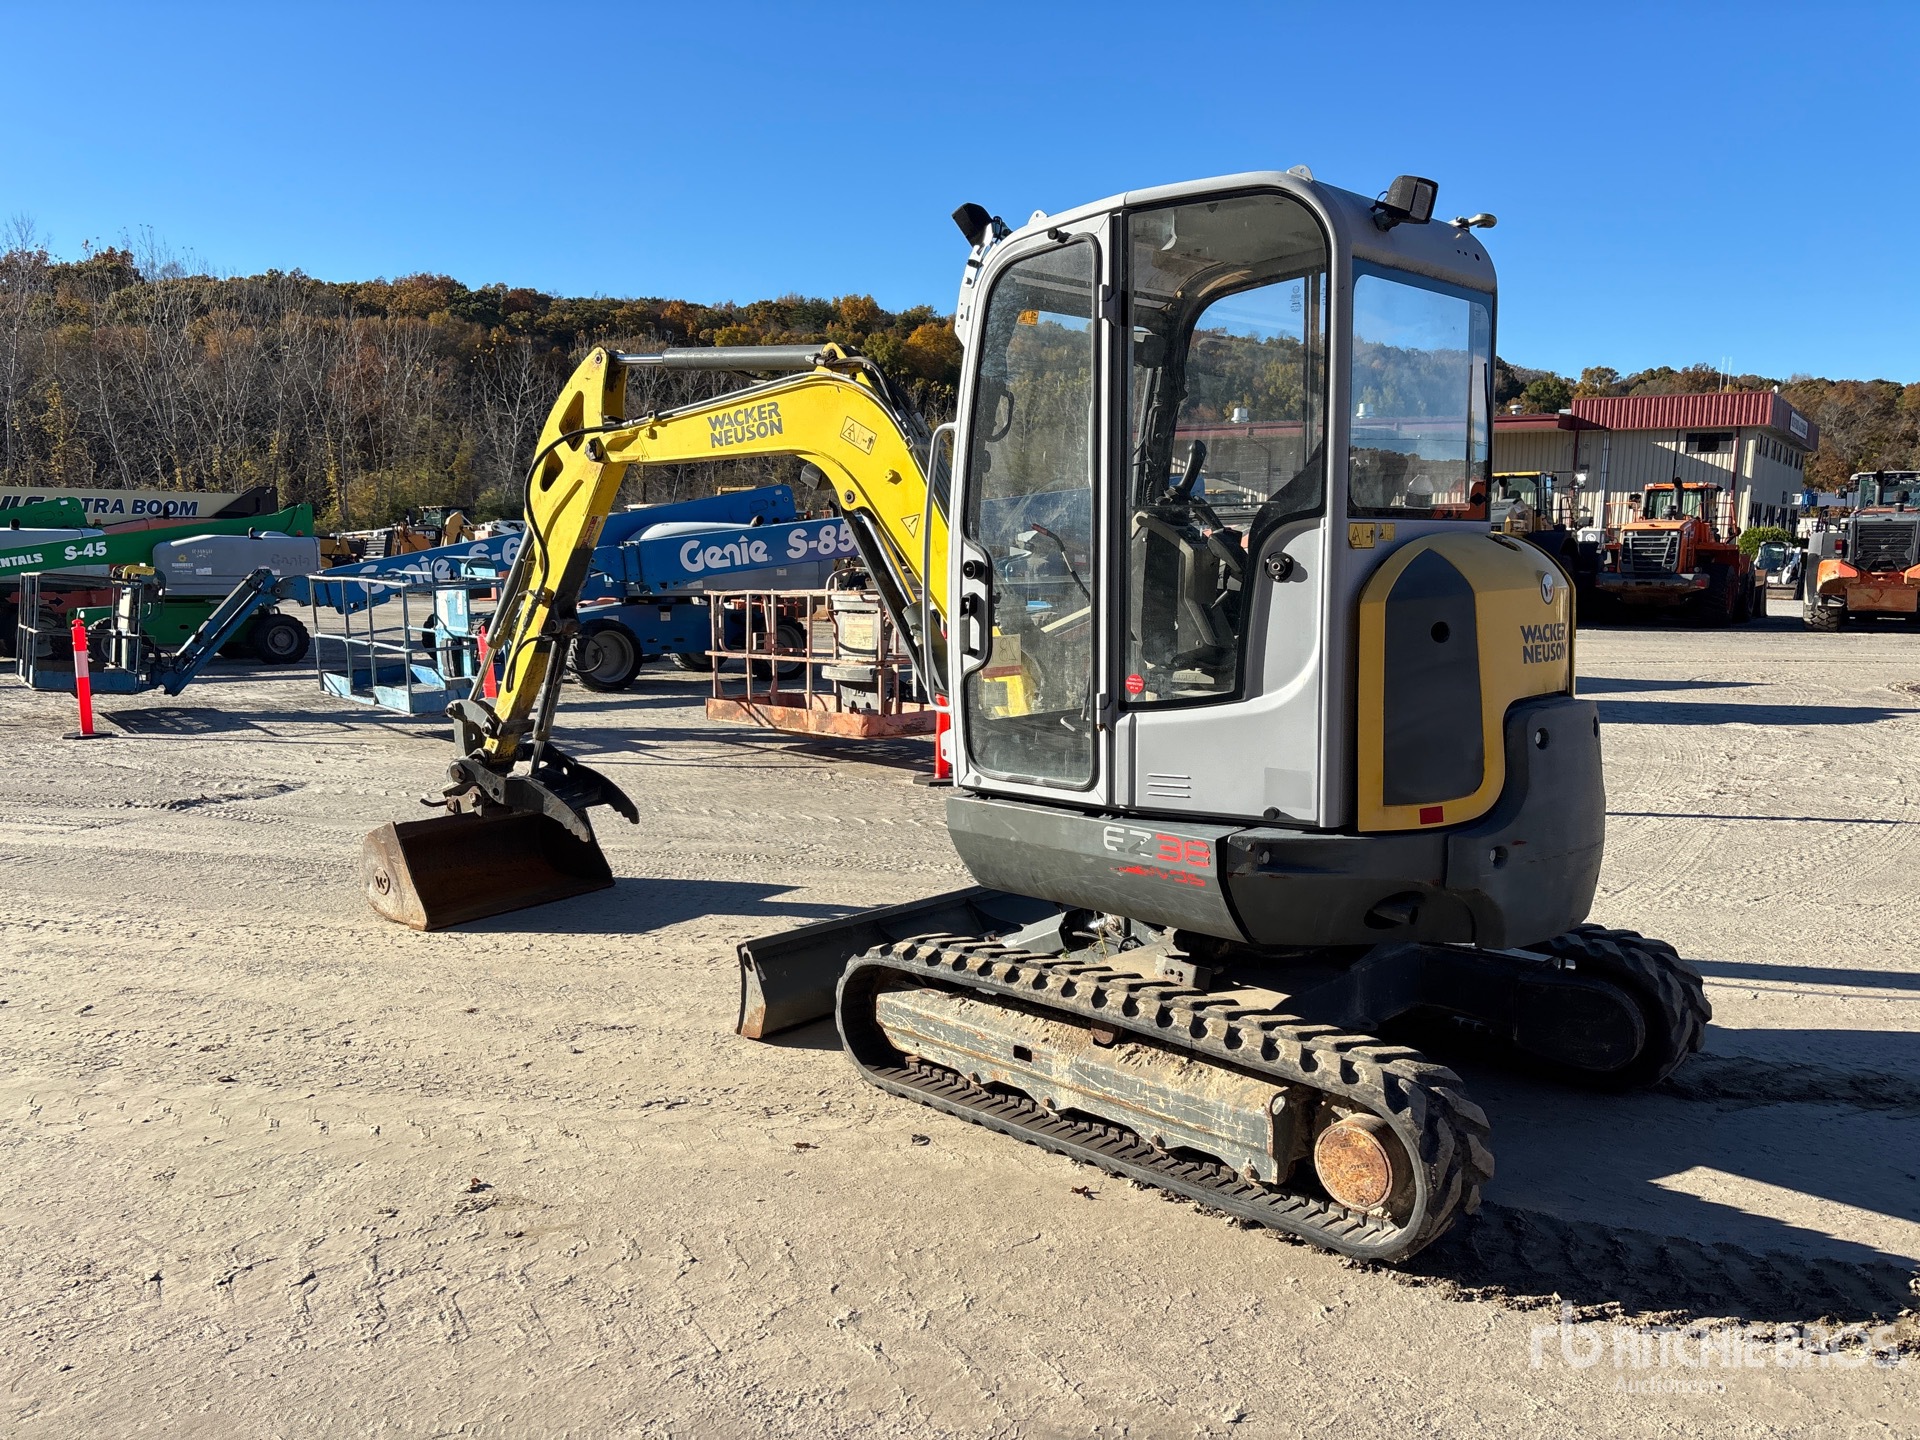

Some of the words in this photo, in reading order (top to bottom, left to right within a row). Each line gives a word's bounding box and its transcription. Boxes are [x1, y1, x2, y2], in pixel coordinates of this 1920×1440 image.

[707, 402, 781, 431] WACKER
[710, 418, 783, 448] NEUSON
[81, 498, 125, 514] TRA
[131, 499, 198, 516] BOOM
[64, 541, 107, 561] S-45
[680, 535, 768, 573] Genie
[787, 525, 854, 559] S-85
[0, 553, 43, 568] NTALS
[1520, 623, 1567, 644] WACKER
[1523, 642, 1567, 664] NEUSON
[1103, 826, 1211, 868] EZ38
